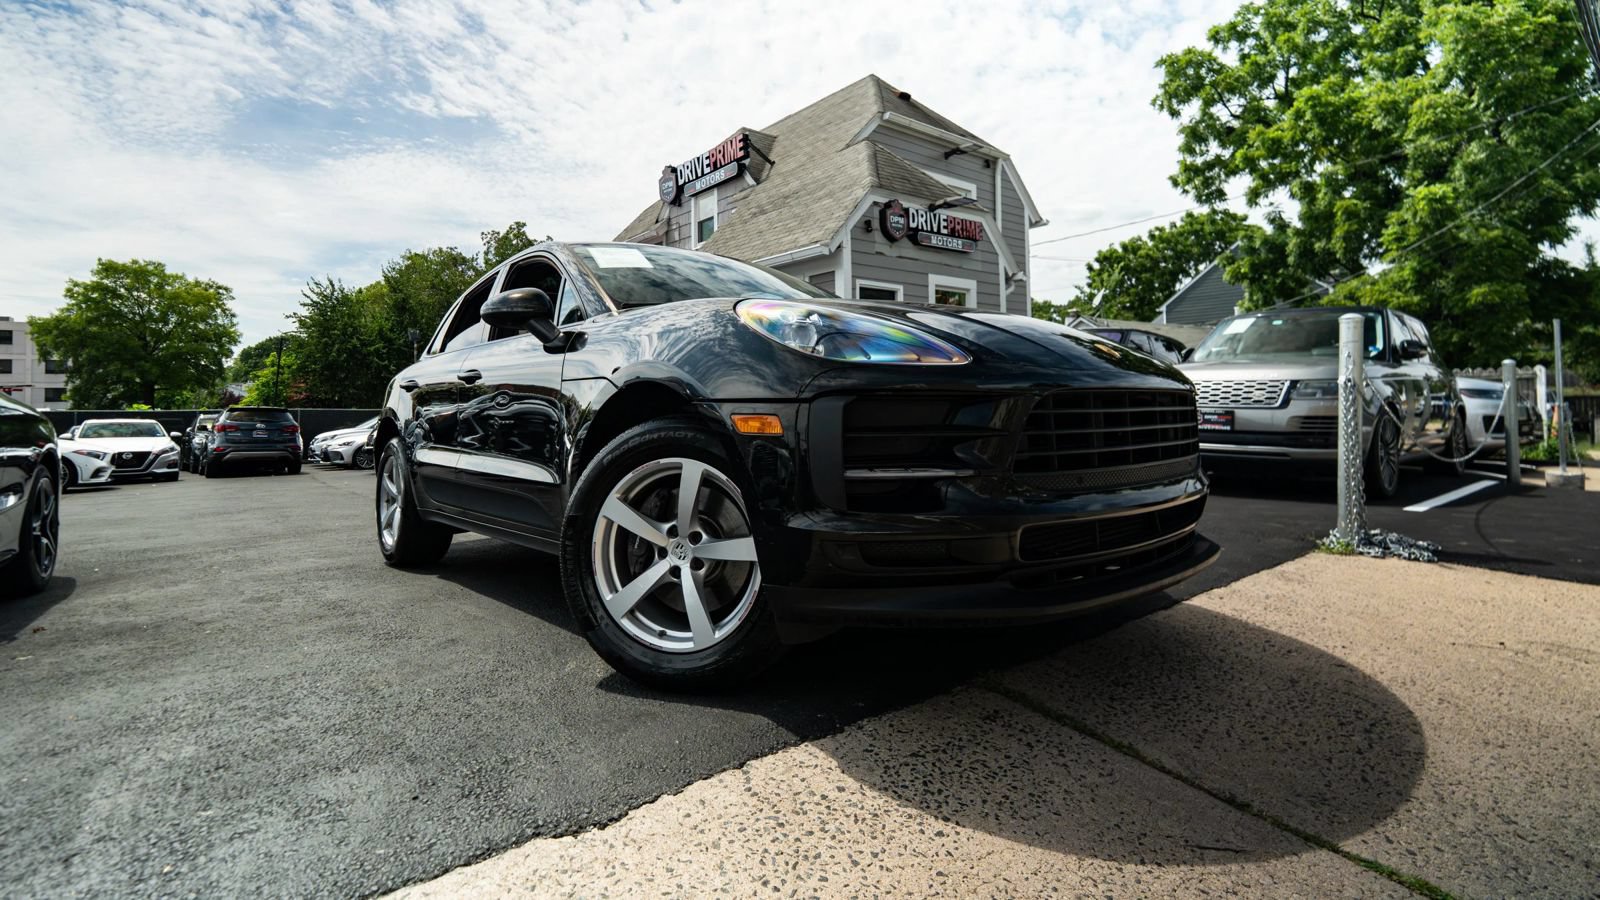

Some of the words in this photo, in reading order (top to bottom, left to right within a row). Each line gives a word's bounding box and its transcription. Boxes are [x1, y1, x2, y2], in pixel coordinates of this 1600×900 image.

[677, 133, 745, 186] DRIVEPRIME
[695, 169, 725, 190] MOTORS
[890, 215, 904, 224] DPM
[908, 207, 983, 240] DRIVEPRIME
[931, 235, 962, 249] MOTORS
